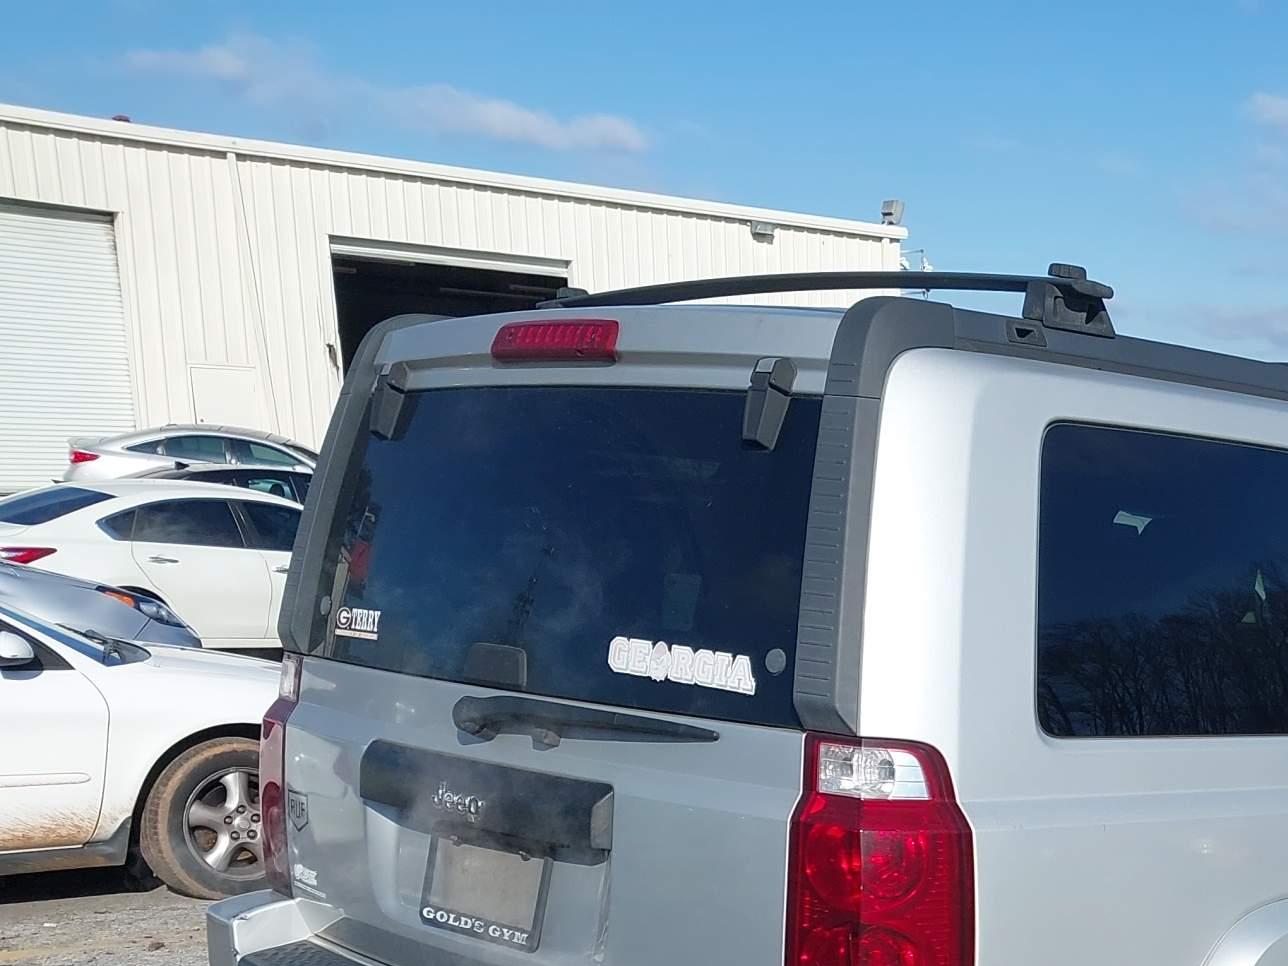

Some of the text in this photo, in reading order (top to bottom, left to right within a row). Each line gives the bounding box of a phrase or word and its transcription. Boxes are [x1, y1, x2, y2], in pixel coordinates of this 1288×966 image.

[351, 608, 381, 632] TERRY
[432, 781, 485, 822] Jeep
[422, 907, 528, 945] GOLD'S GYM
